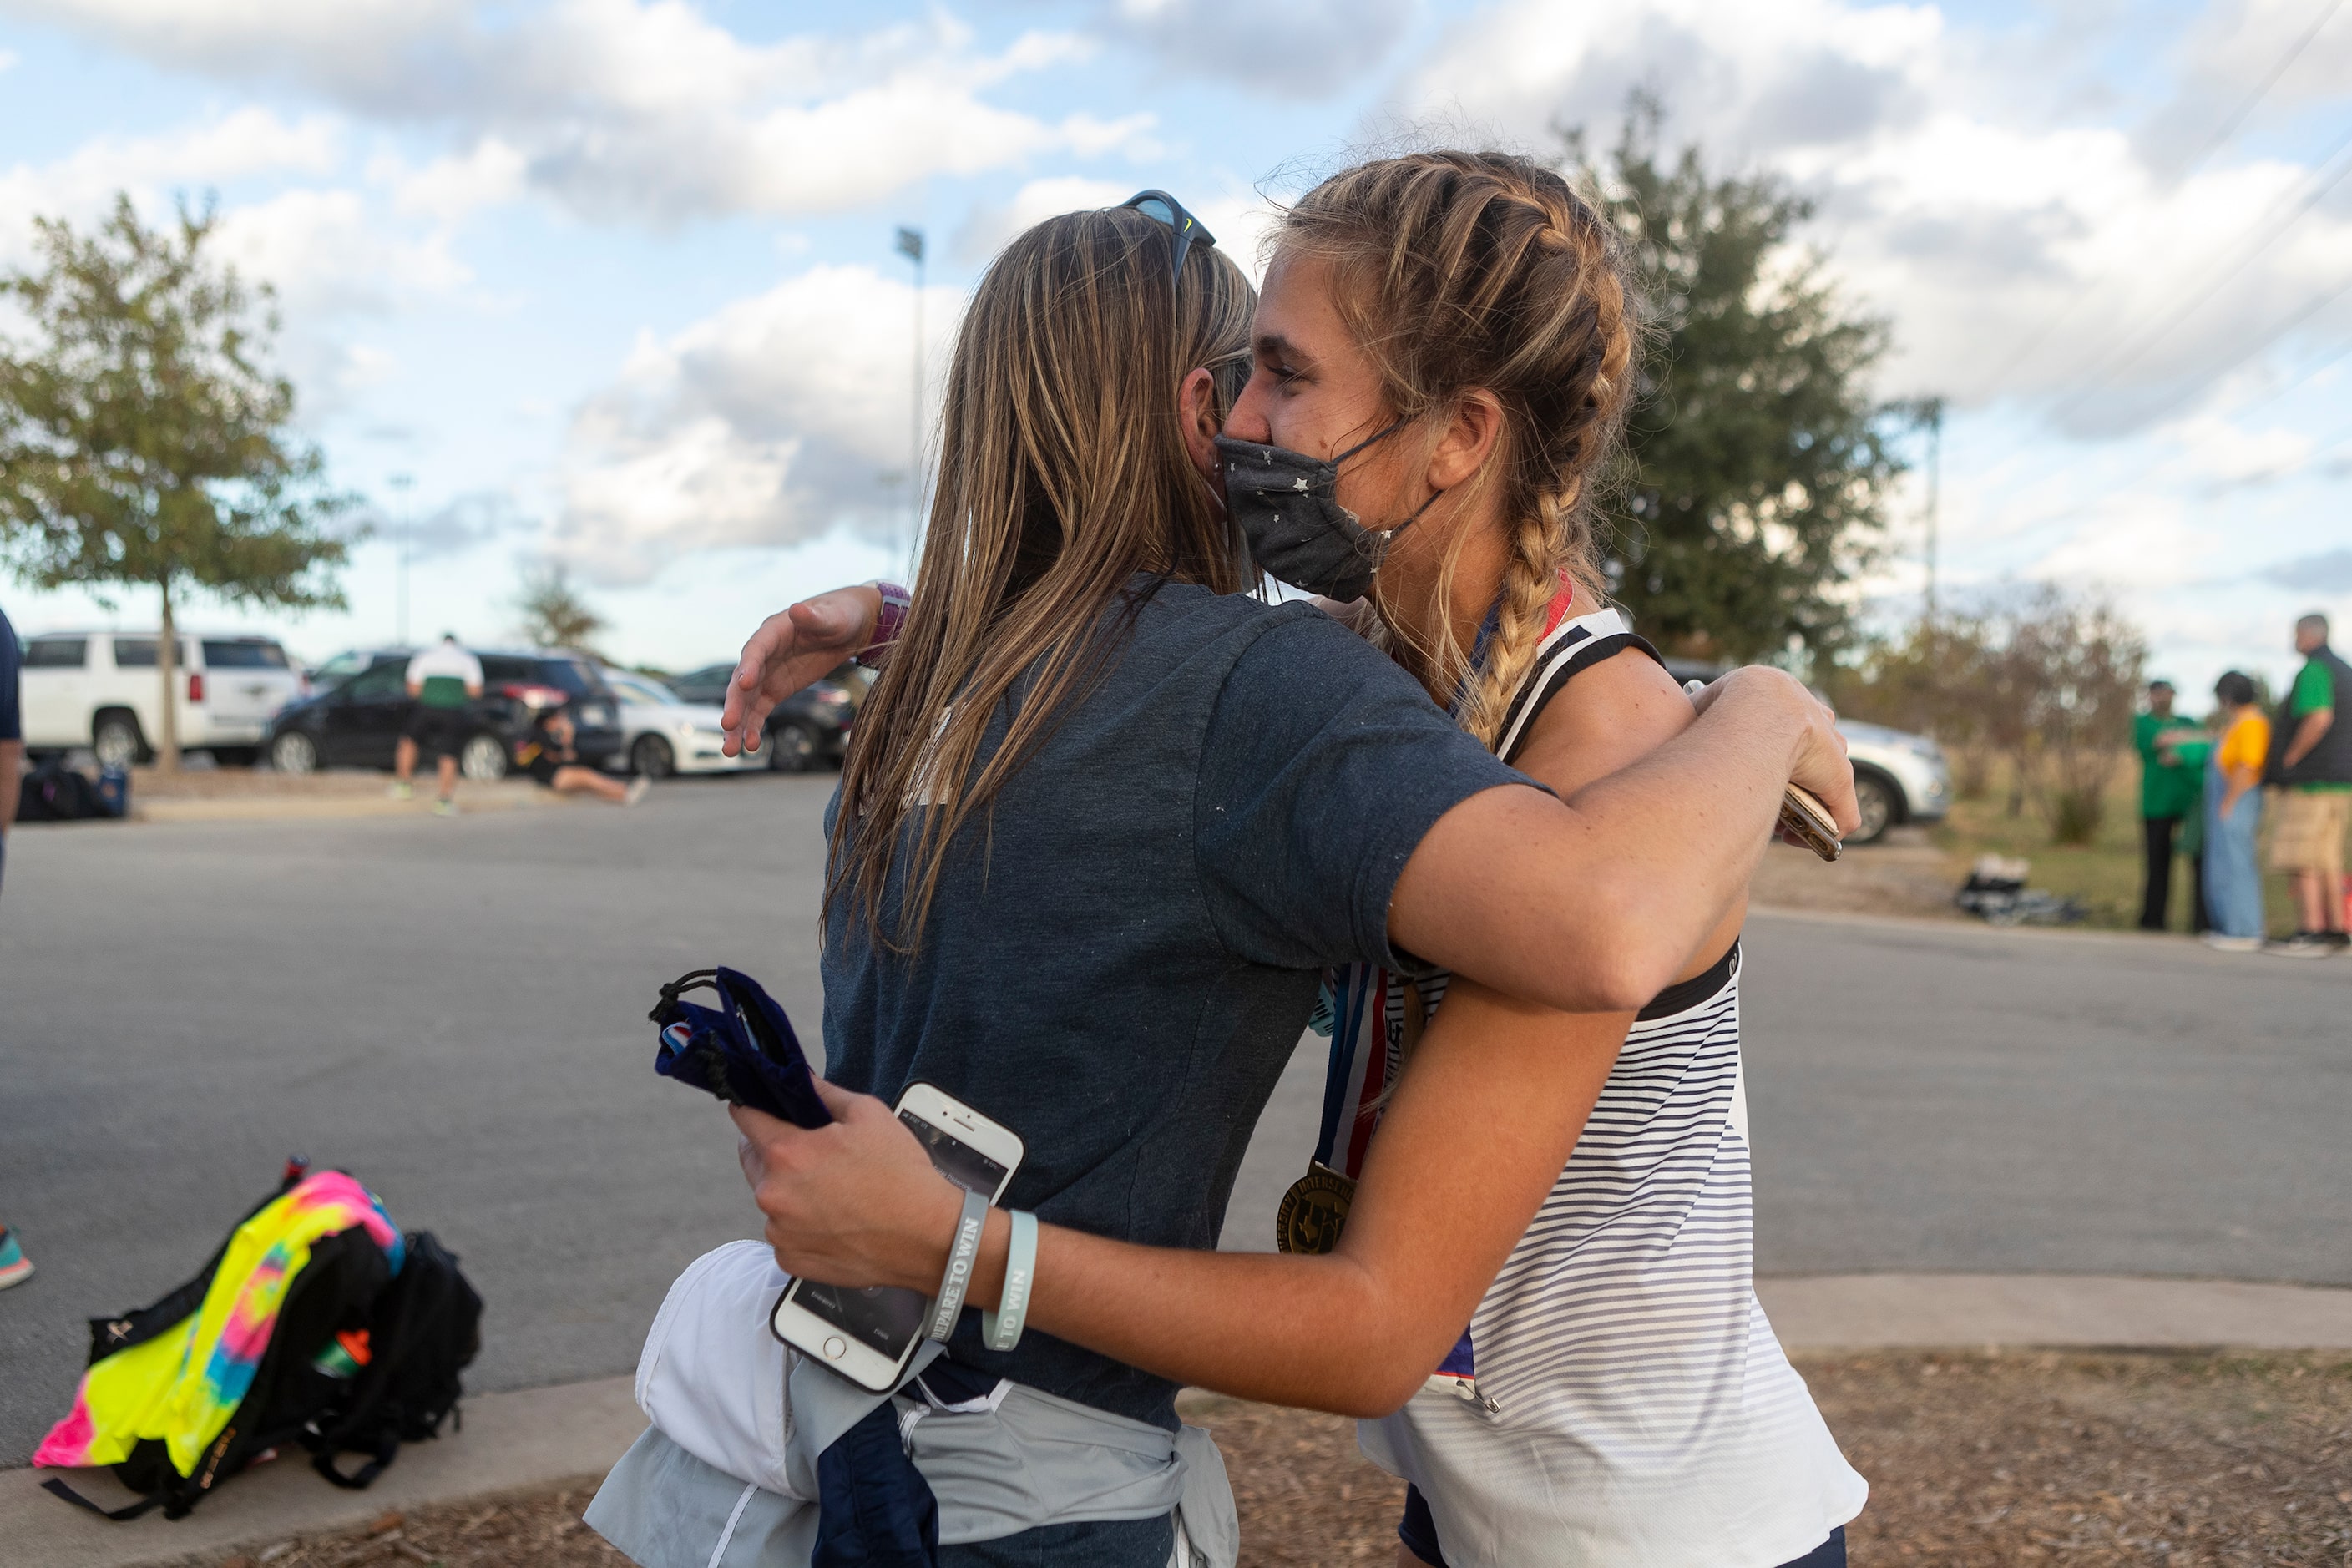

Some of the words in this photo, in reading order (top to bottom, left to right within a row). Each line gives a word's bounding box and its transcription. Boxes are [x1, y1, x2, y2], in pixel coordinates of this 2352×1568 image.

[956, 1216, 979, 1257] WIN
[949, 1258, 968, 1285] TO
[1006, 1268, 1026, 1311] WIN
[929, 1284, 961, 1342] REPARE
[999, 1315, 1017, 1338] TO
